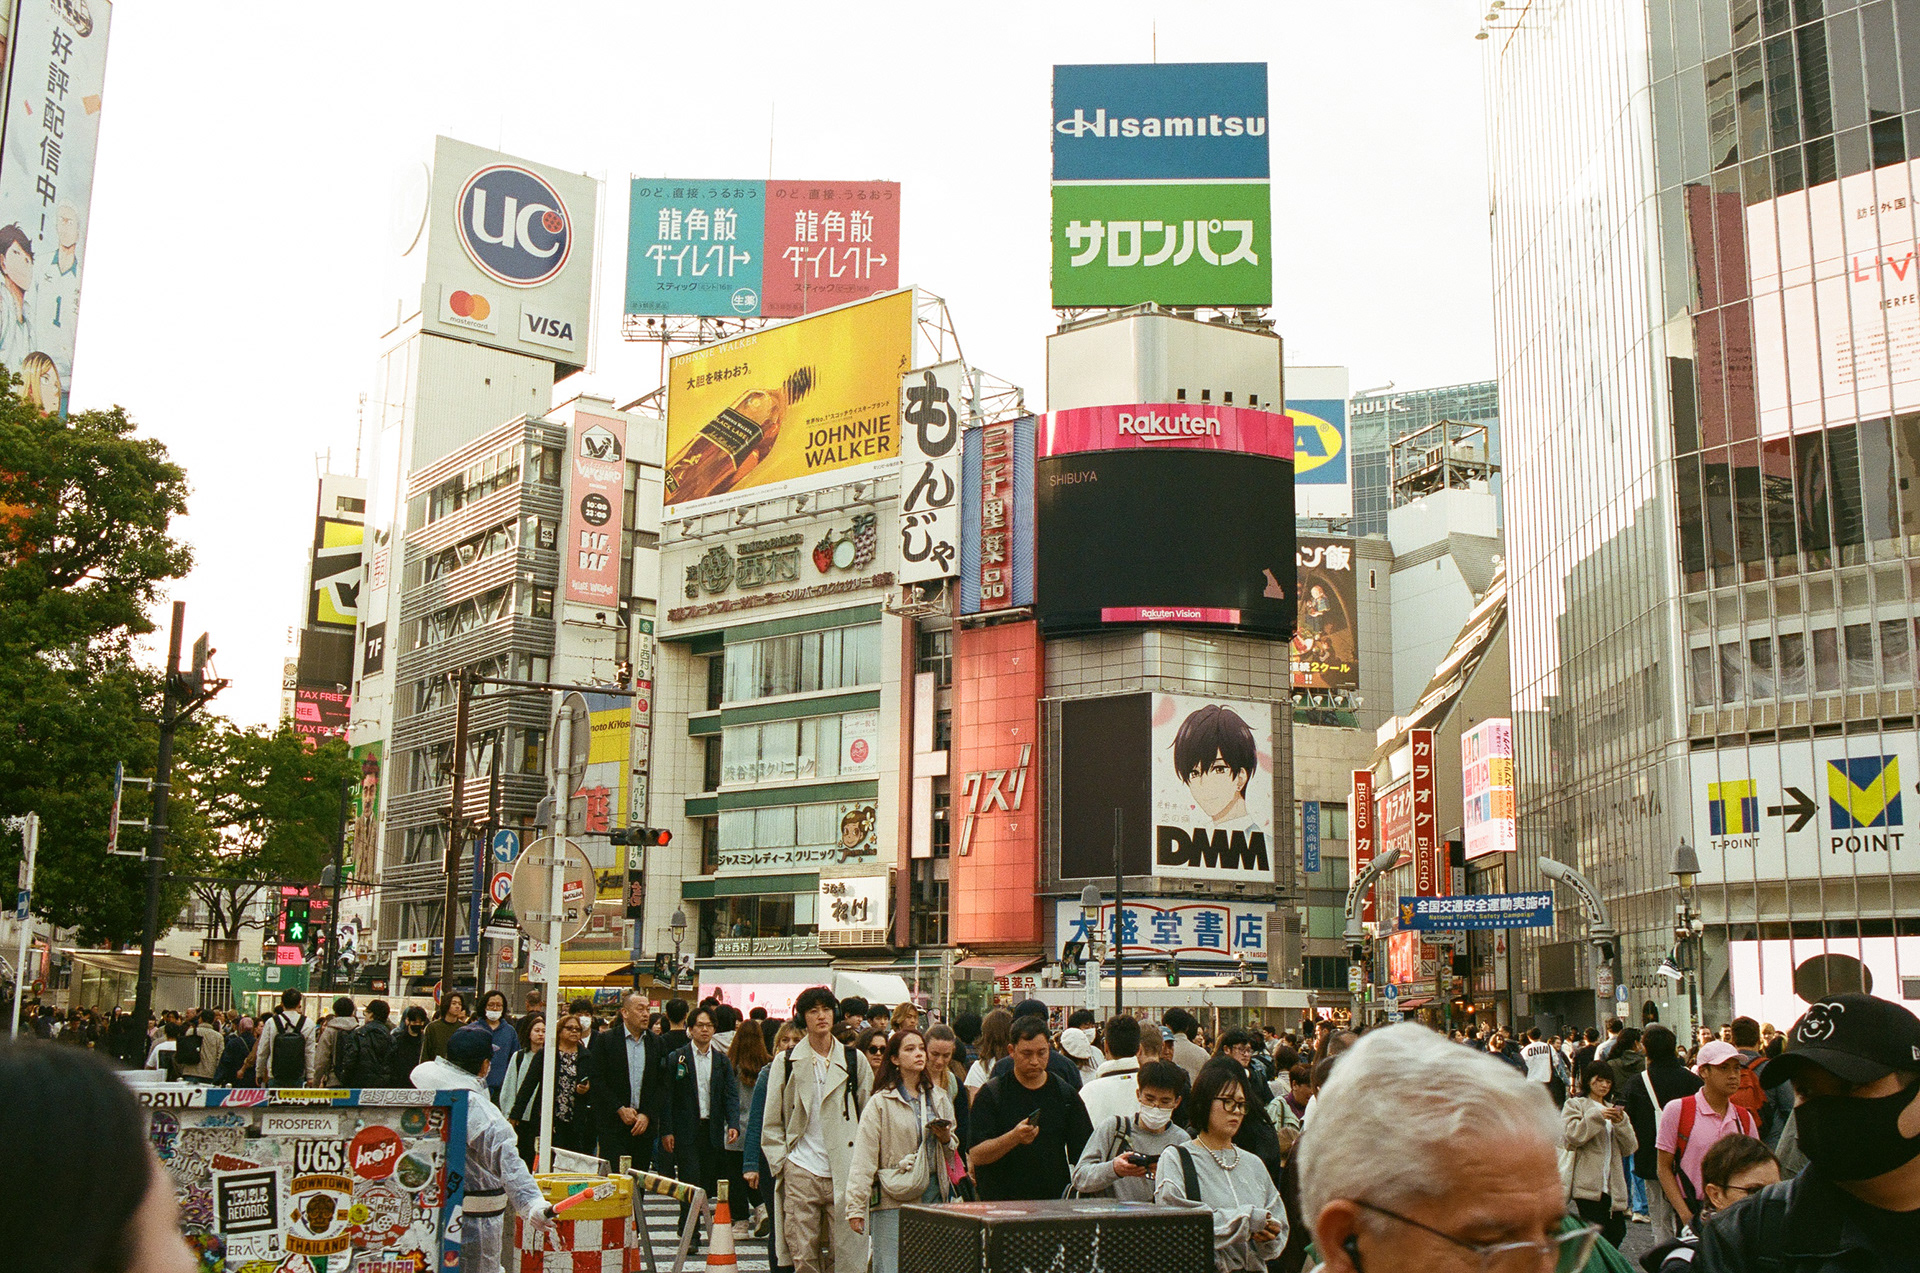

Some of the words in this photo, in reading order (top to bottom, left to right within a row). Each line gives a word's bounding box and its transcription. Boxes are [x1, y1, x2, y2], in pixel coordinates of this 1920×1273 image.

[1055, 109, 1266, 137] Hisamitsu
[639, 187, 757, 199] のど、直接、うるおう
[776, 188, 894, 201] のど、直接、うるおう
[658, 207, 738, 241] 龍角散
[795, 209, 874, 243] 龍角散
[1065, 219, 1259, 267] サロンパス
[645, 244, 751, 277] ダイレクト
[782, 246, 888, 279] ダイレクト
[1853, 242, 1920, 284] LIV
[656, 282, 698, 291] スティック
[793, 283, 835, 292] スティック
[450, 316, 489, 330] mastercard
[524, 313, 573, 341] VISA
[674, 348, 715, 369] JOHNNIE
[718, 336, 759, 354] WALKER
[686, 362, 752, 390] 大胆を味わおう。
[805, 414, 891, 450] JOHNNIE
[1118, 411, 1221, 441] Rakuten
[805, 435, 890, 468] WALKER
[904, 370, 957, 573] もんじゃ
[1050, 470, 1098, 487] SHIBUYA
[980, 427, 1007, 600] 三千里薬品
[581, 530, 609, 551] B1F
[579, 550, 609, 572] B2F
[1141, 608, 1175, 619] Rakuten
[1175, 608, 1201, 618] Vision
[368, 637, 383, 659] 7F
[298, 690, 318, 700] TAX
[320, 692, 343, 702] FREE
[296, 724, 315, 733] TAX
[317, 725, 341, 736] FRE
[1414, 741, 1432, 827] カラオケ
[957, 743, 1033, 857] クスリ
[1386, 788, 1411, 824] カラオケ
[1156, 825, 1270, 871] DMM
[1418, 837, 1429, 858] BIG
[1710, 837, 1761, 851] T-POINT
[1831, 833, 1905, 854] POINT
[1418, 859, 1430, 891] ECHO
[1416, 895, 1550, 914] 全国交通安全運動実施中
[1069, 909, 1263, 949] 大盛堂書店
[359, 1088, 437, 1105] aspects
[297, 1140, 343, 1172] UGS
[294, 1177, 351, 1192] DOWNTOWN
[227, 1203, 269, 1221] RECORDS
[287, 1238, 347, 1255] THAILAND
